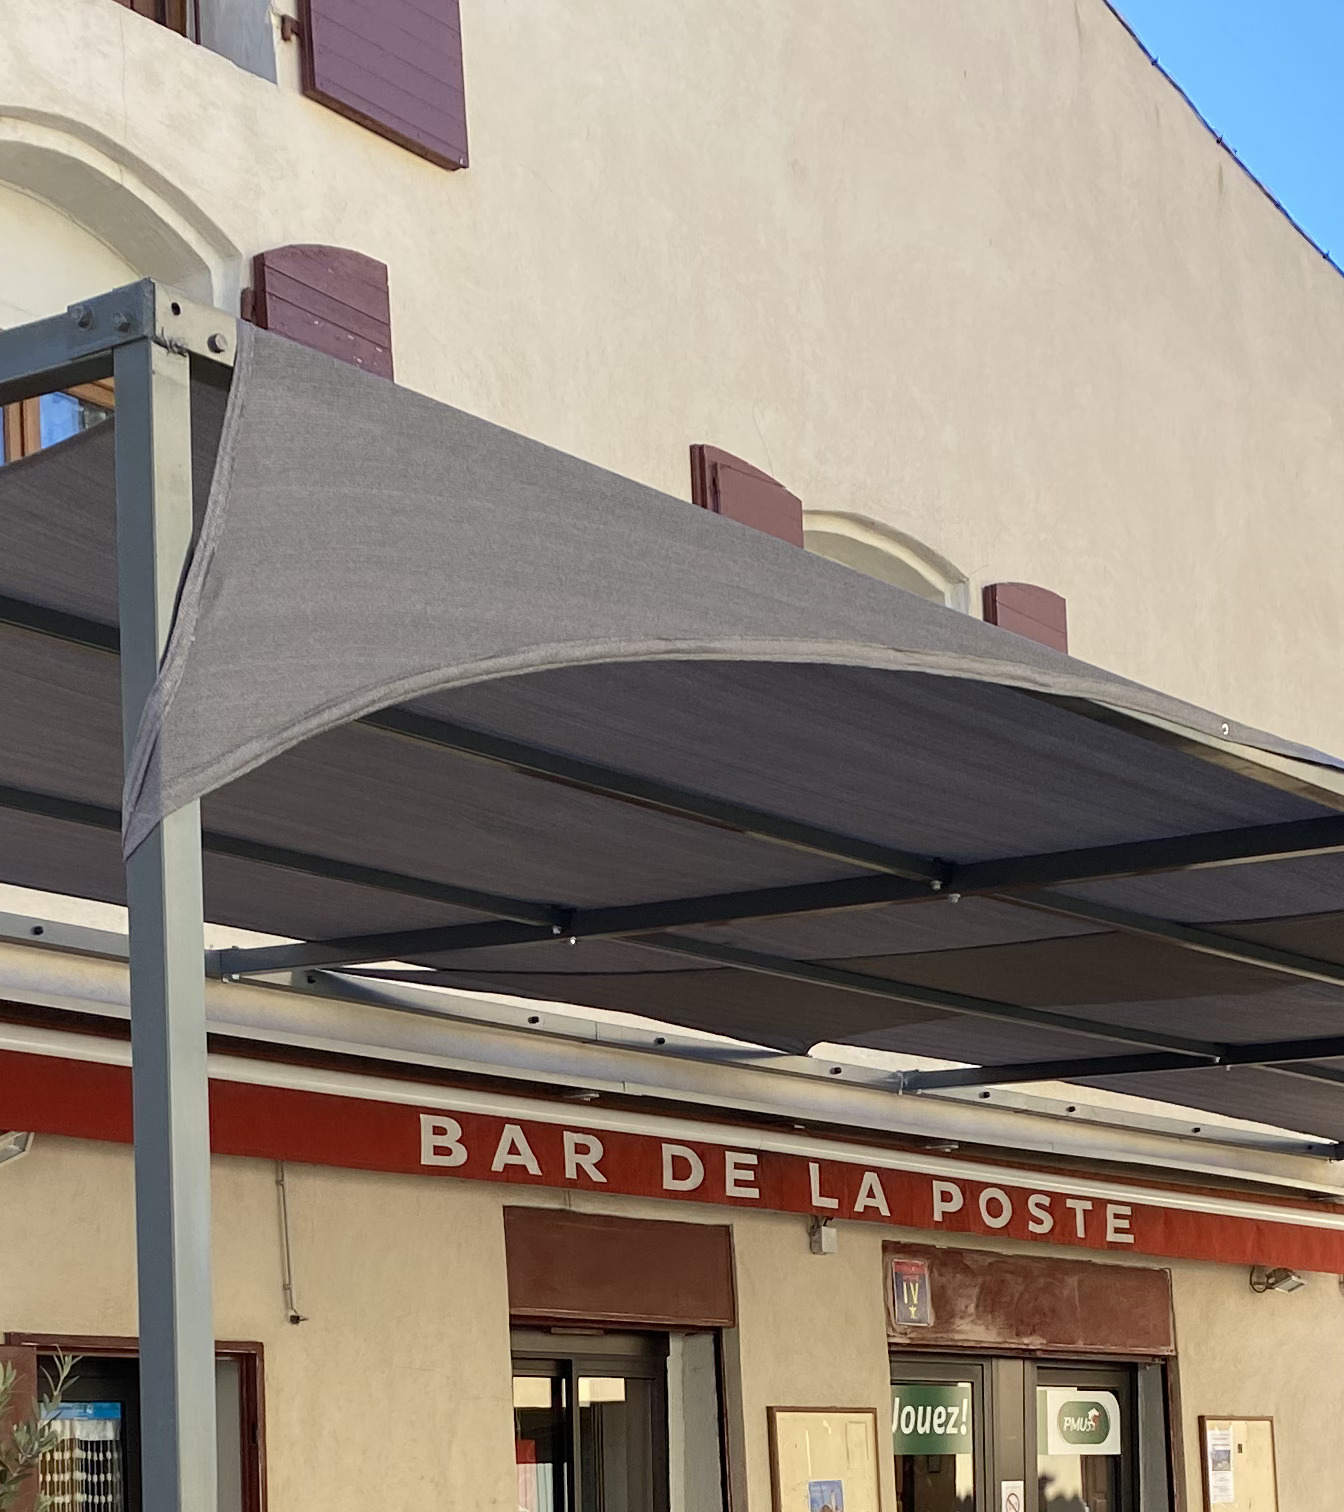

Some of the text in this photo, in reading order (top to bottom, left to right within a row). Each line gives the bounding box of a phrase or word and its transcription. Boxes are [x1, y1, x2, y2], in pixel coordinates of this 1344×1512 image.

[419, 1113, 1135, 1244] BAR DE LA POSTE
[892, 1396, 968, 1435] Jouez!
[1062, 1416, 1092, 1432] PMU
